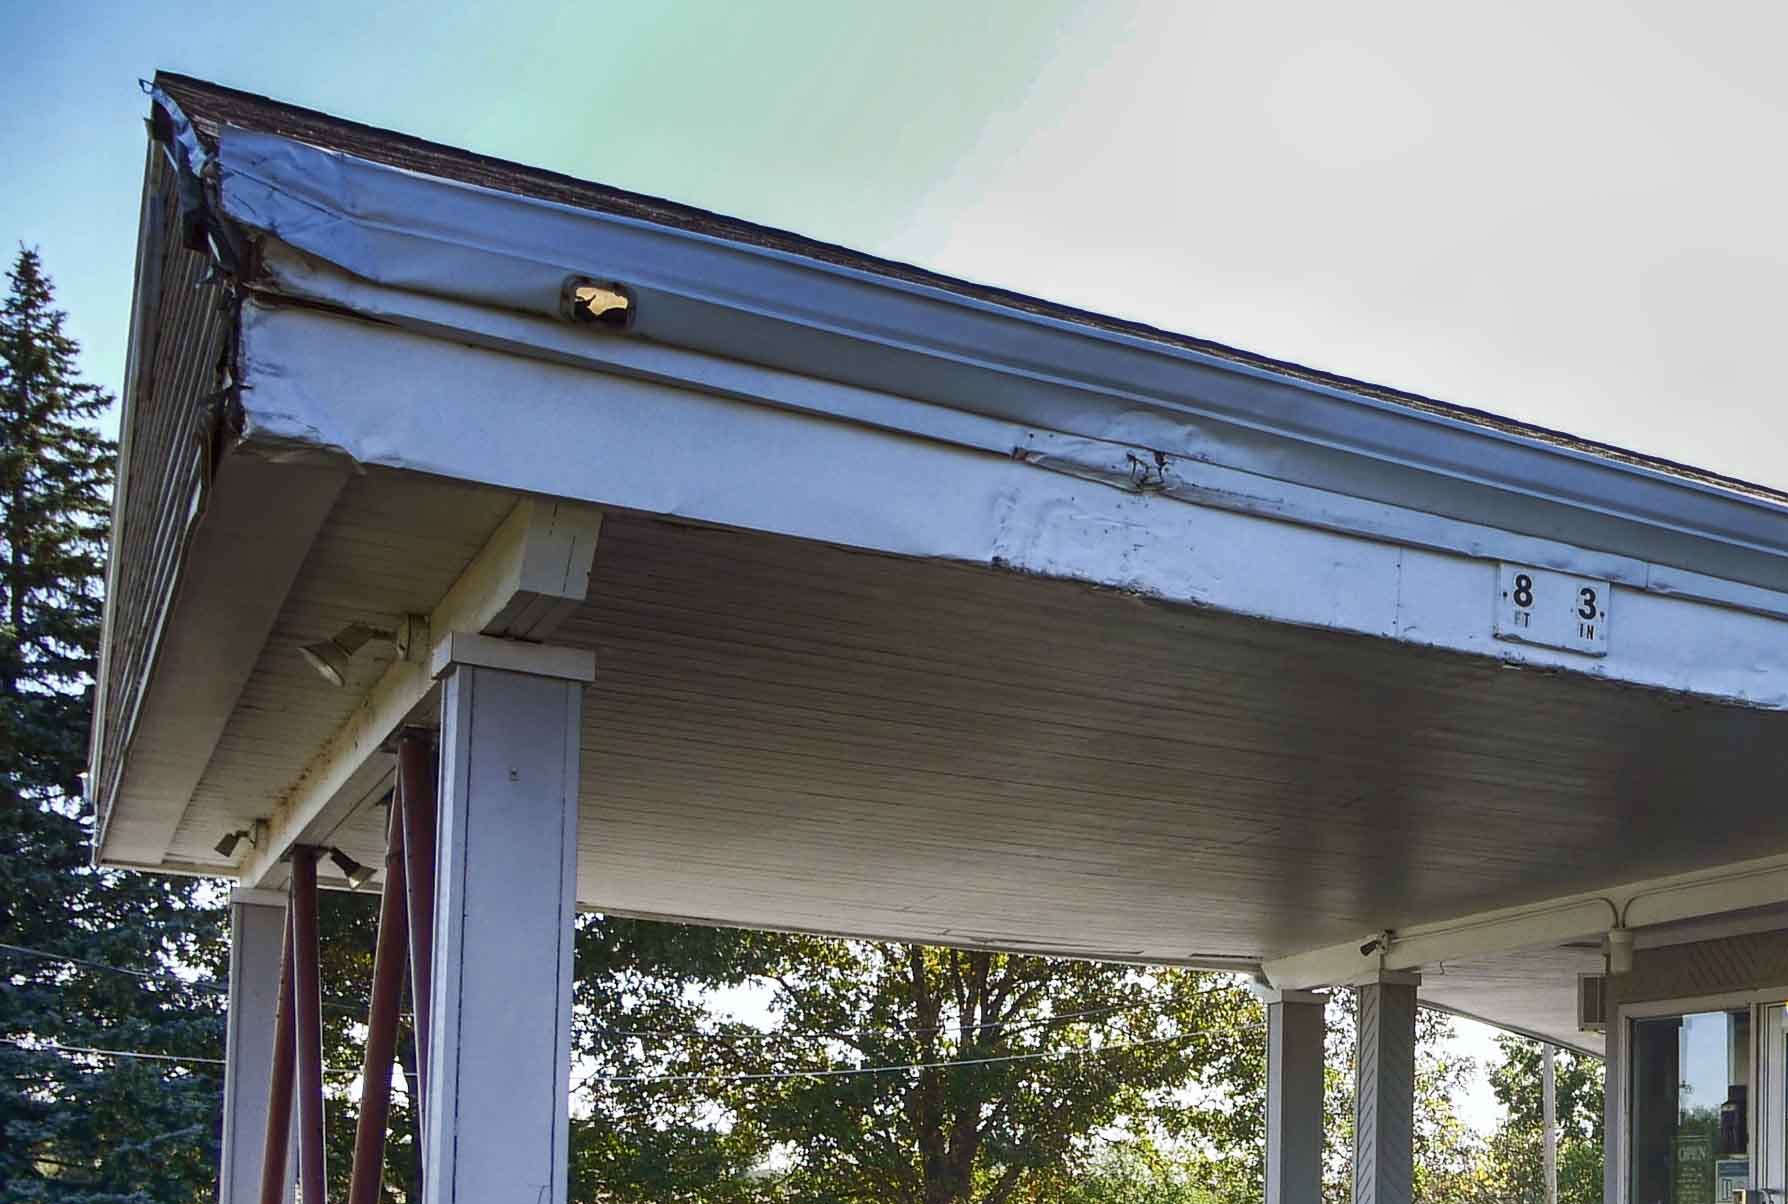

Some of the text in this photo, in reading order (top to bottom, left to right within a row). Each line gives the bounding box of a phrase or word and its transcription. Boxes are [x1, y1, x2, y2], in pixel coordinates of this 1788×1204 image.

[1513, 574, 1597, 620] 8 3
[1579, 623, 1595, 640] IN
